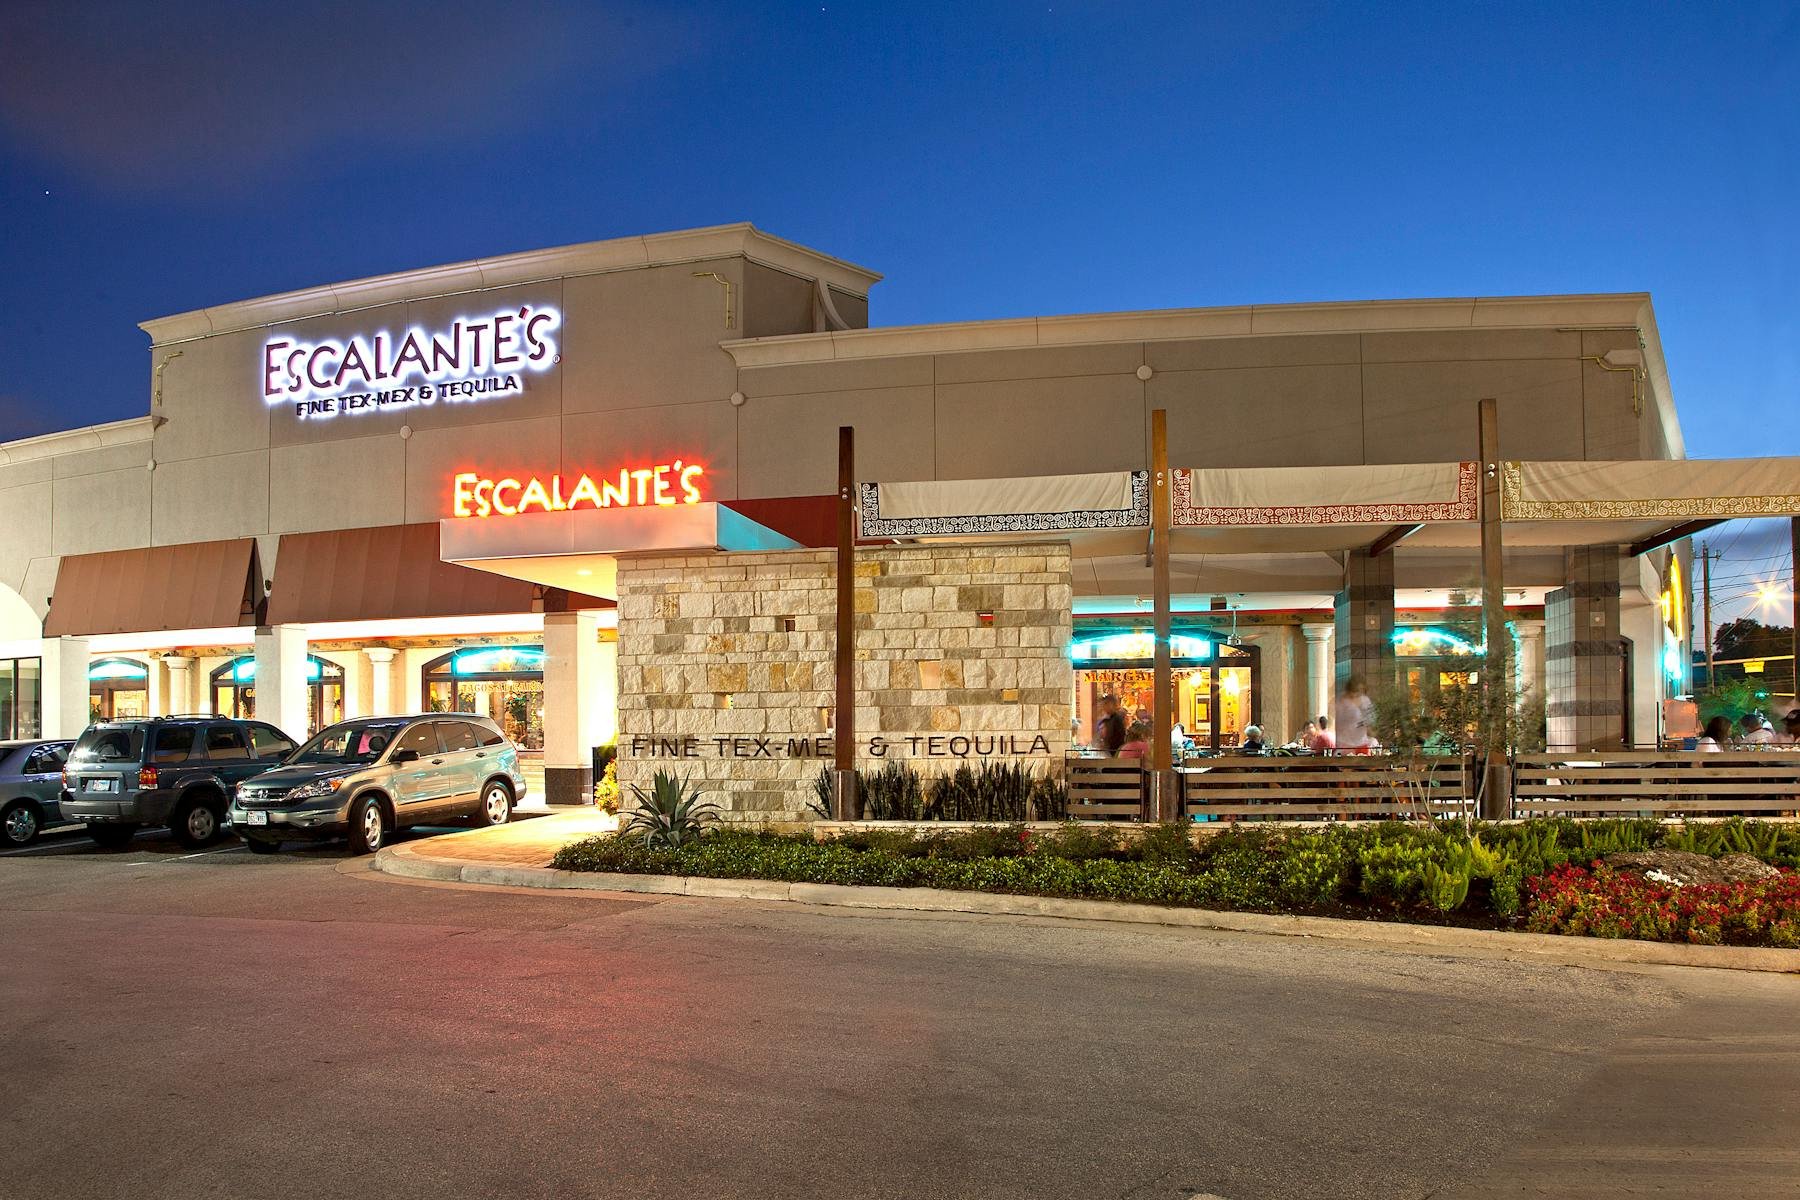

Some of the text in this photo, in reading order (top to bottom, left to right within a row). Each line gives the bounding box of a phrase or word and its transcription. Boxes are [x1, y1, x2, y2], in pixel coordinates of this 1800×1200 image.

[265, 306, 552, 396] ESCALANTE'S
[296, 375, 518, 416] FINE TEX-MEX & TEQUILA
[453, 460, 704, 517] ESCALANTE'S
[632, 735, 1051, 759] FINE TEX-ME & TEQUILA
